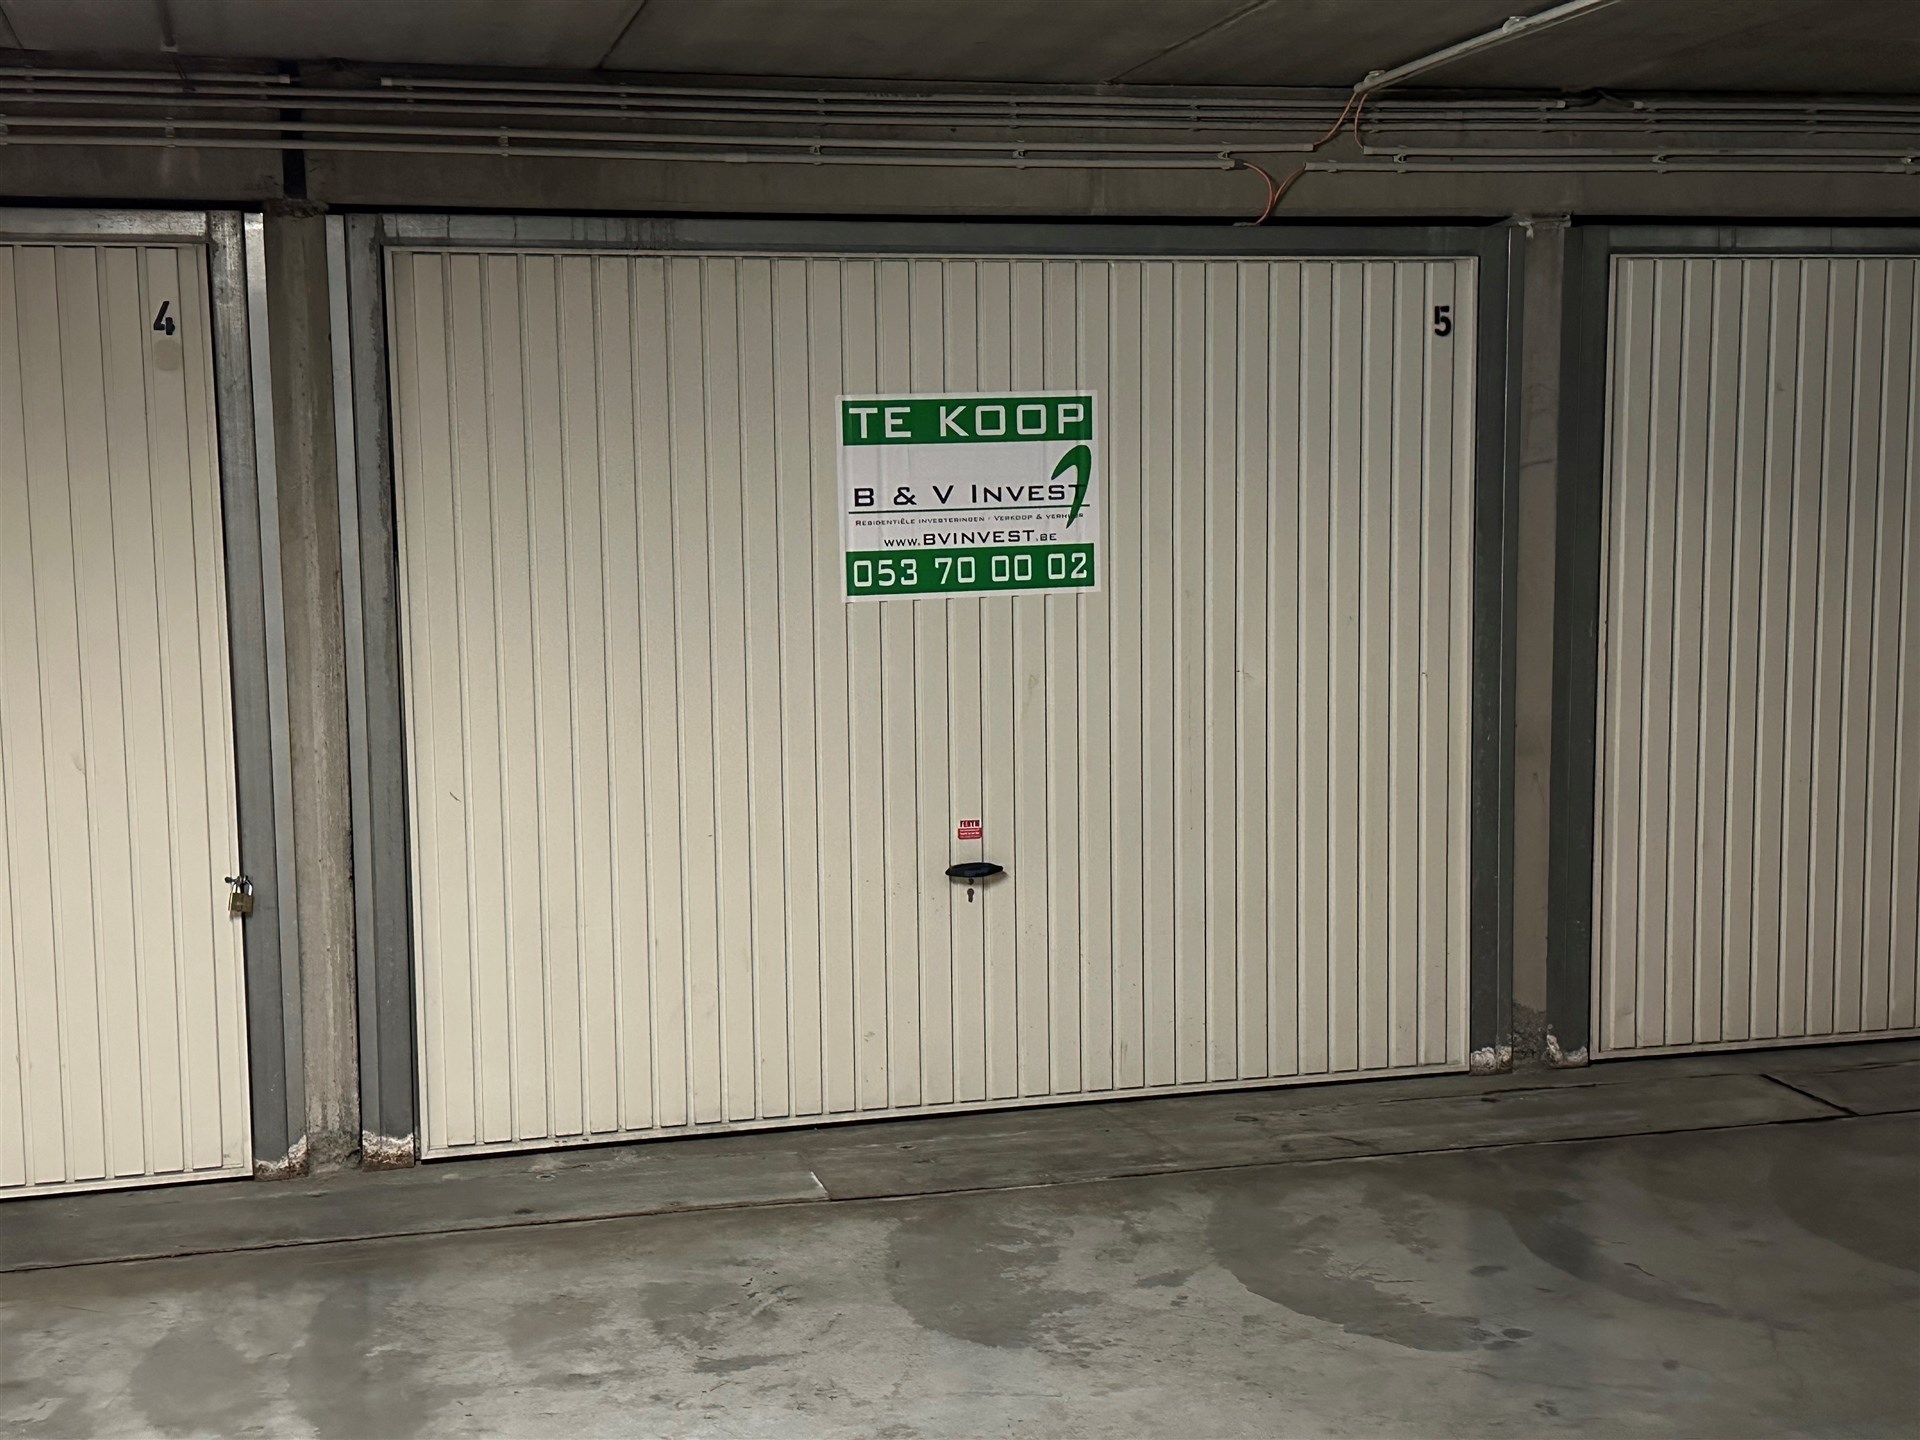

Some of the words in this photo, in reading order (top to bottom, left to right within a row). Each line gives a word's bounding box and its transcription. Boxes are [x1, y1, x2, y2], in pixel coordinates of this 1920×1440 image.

[153, 300, 176, 336] 4
[1434, 305, 1452, 337] 5
[849, 405, 912, 439] TE
[939, 403, 1084, 438] KOOP
[854, 487, 875, 507] B
[893, 486, 917, 506] &
[932, 484, 954, 505] V
[853, 558, 918, 587] 053
[934, 556, 976, 585] 70
[991, 554, 1032, 582] 00
[1047, 552, 1087, 580] 02
